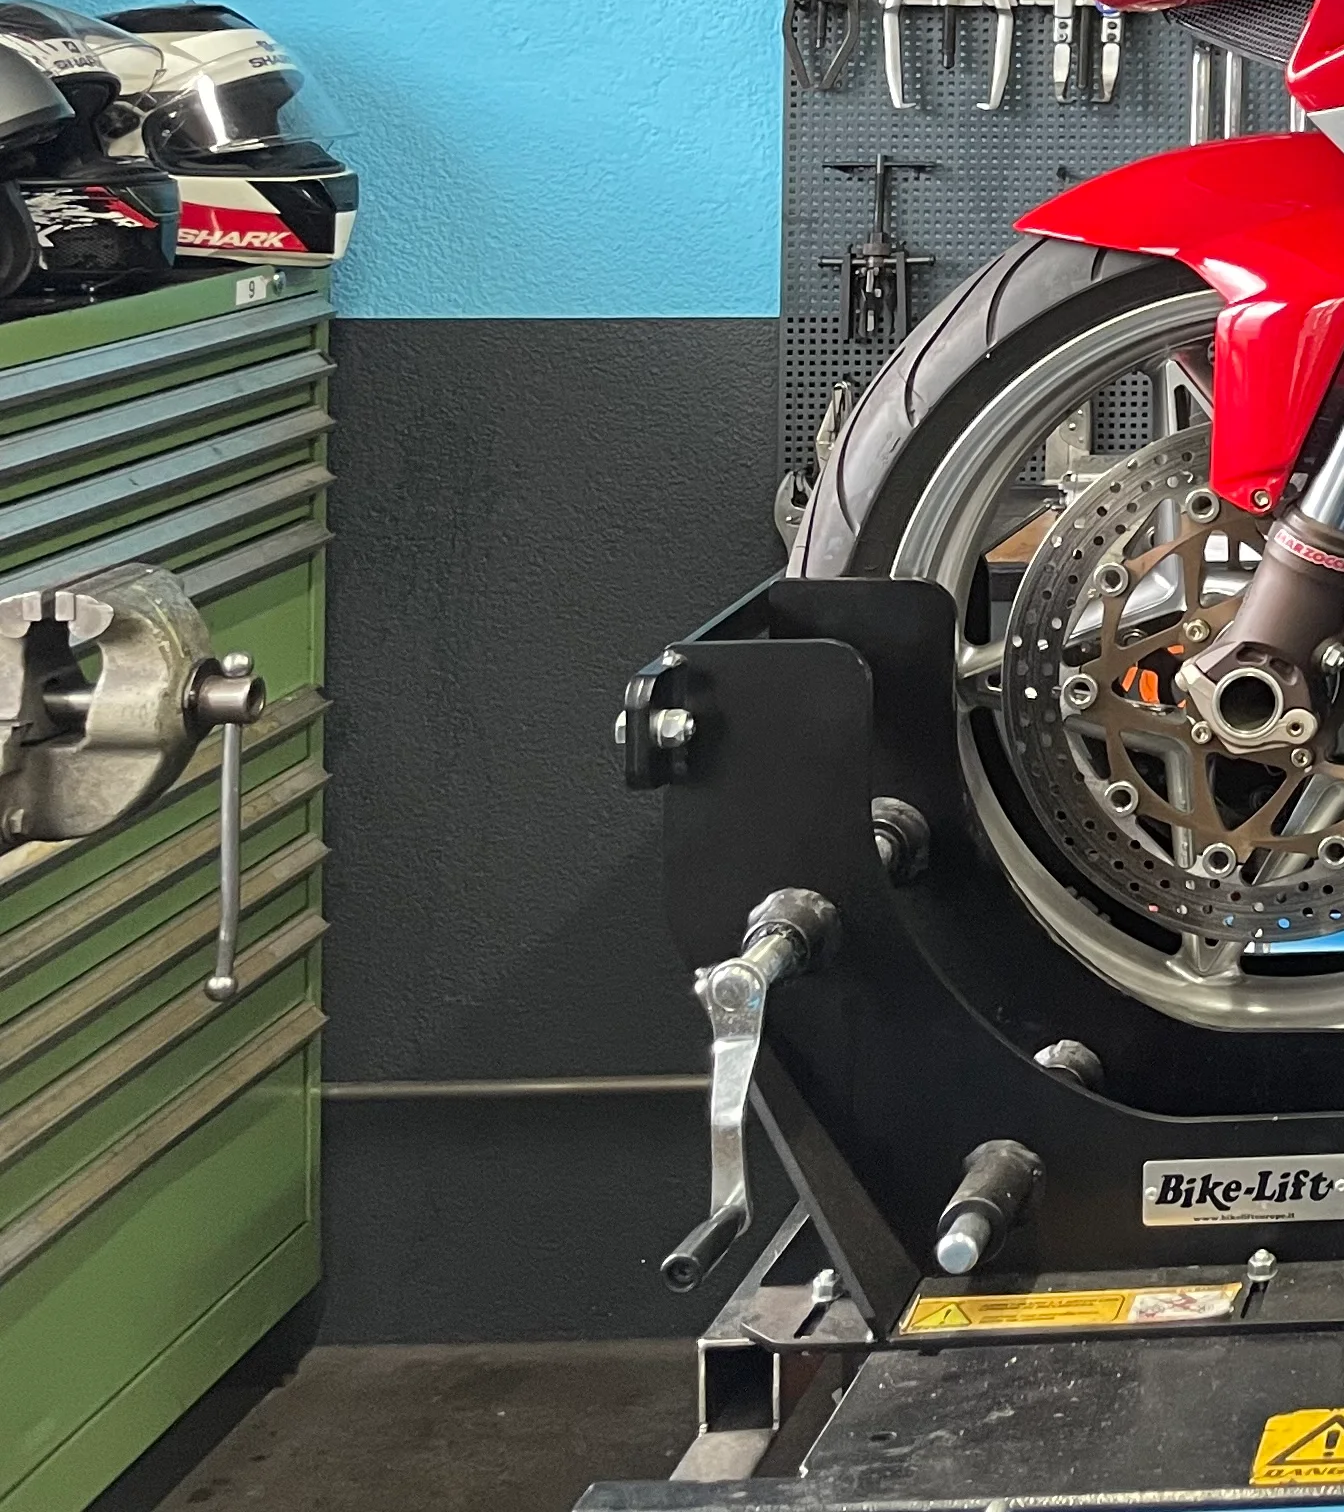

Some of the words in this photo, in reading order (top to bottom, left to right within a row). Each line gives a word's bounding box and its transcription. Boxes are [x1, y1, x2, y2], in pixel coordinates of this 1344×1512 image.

[177, 231, 290, 249] SHARK
[246, 280, 256, 298] 9
[1155, 1169, 1335, 1212] Bike-Lift
